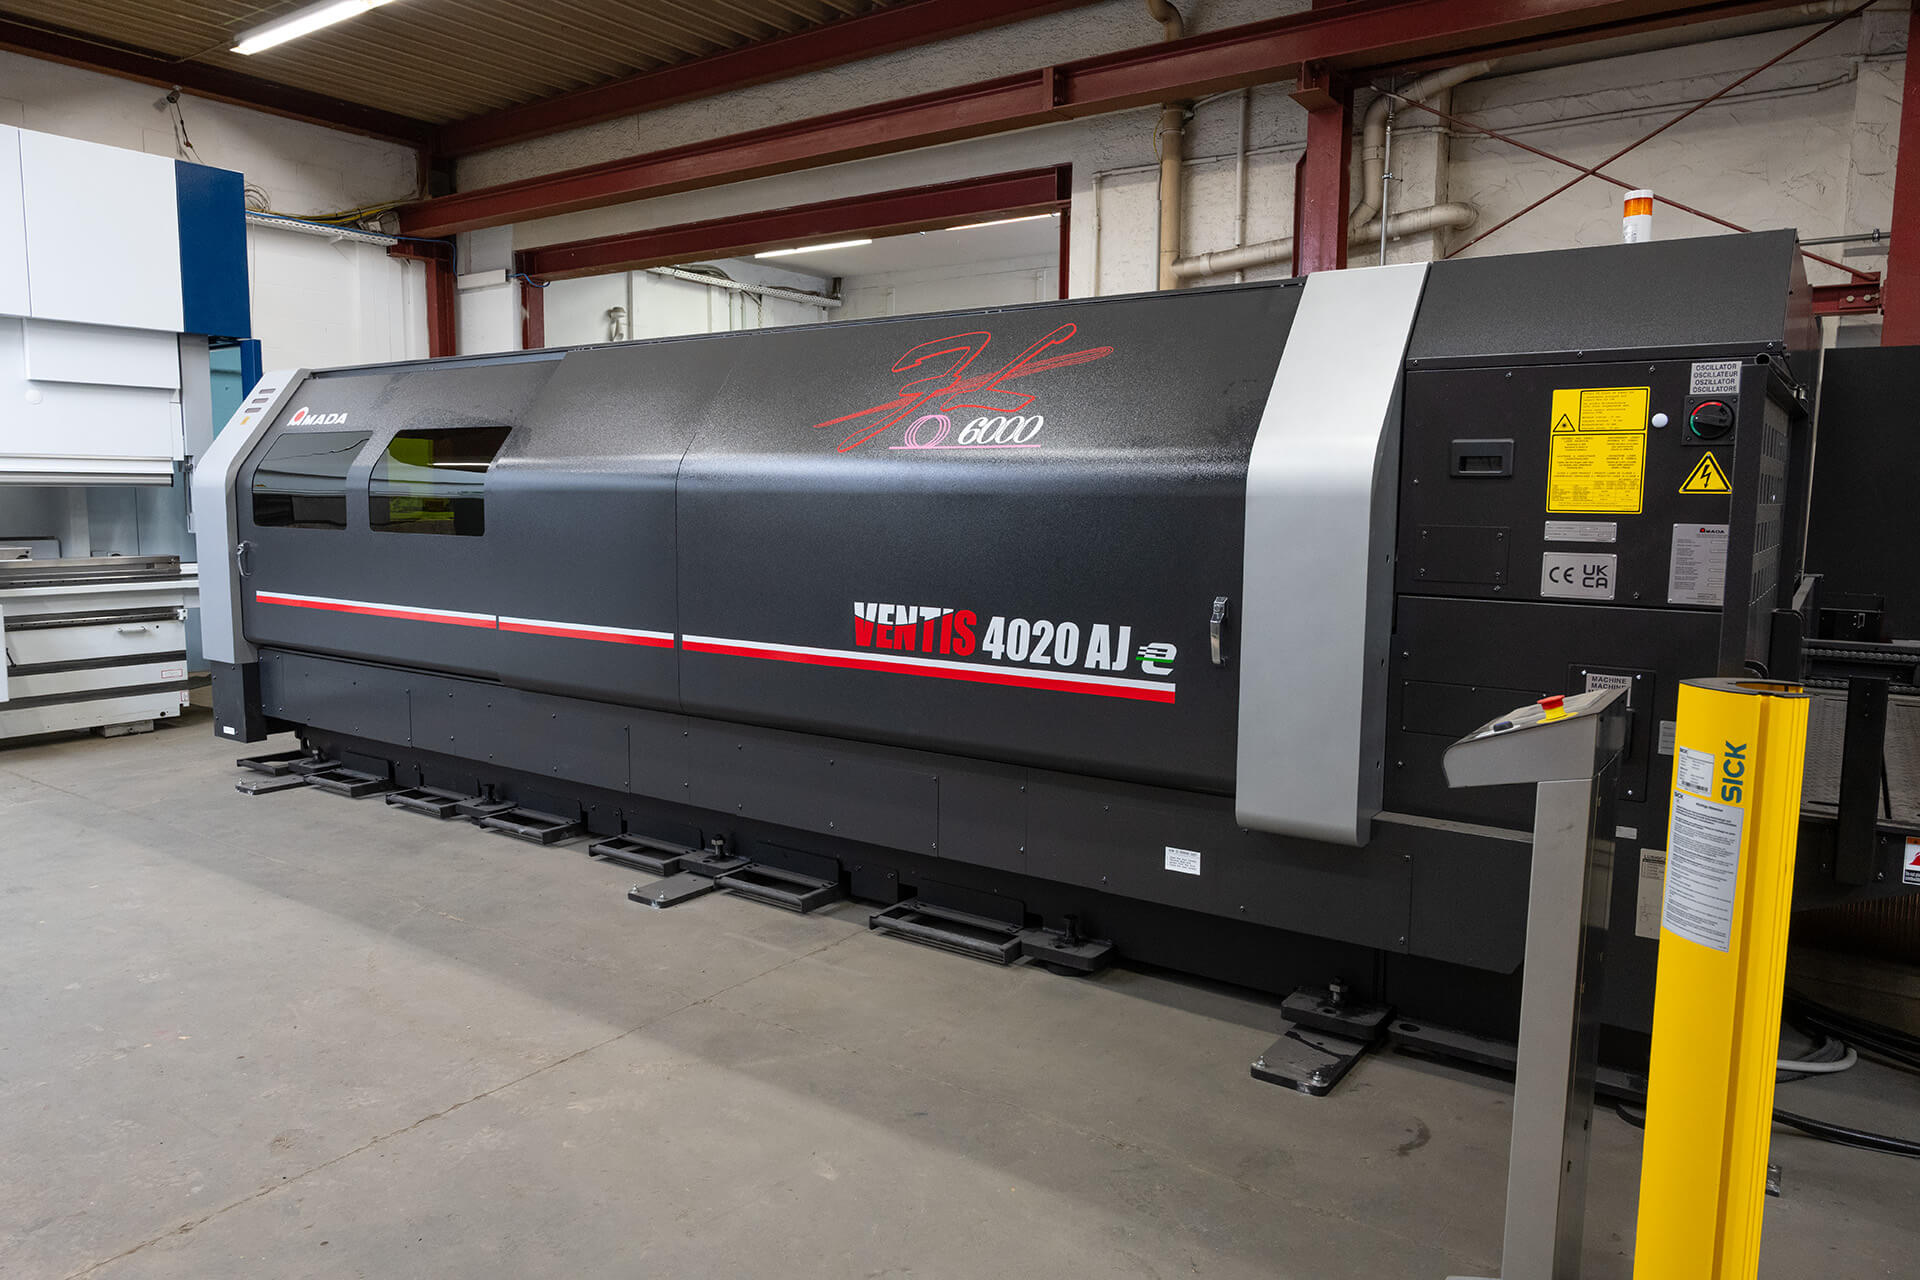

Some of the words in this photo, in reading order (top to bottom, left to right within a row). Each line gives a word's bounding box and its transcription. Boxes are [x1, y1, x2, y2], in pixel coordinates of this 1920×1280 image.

[1696, 363, 1737, 371] OSCILLATOR
[1692, 385, 1737, 393] OSCILLATORE
[1695, 378, 1736, 386] OSZILLATOR
[286, 406, 348, 426] AMADA
[958, 414, 1044, 445] 6000
[1549, 566, 1575, 584] CE
[1583, 564, 1608, 576] UK
[1582, 577, 1608, 589] CA
[854, 602, 977, 656] VENTIS
[982, 616, 1080, 666] 4020
[1084, 623, 1132, 671] AJ
[1591, 676, 1627, 684] MACHINE
[1721, 740, 1747, 804] SICK
